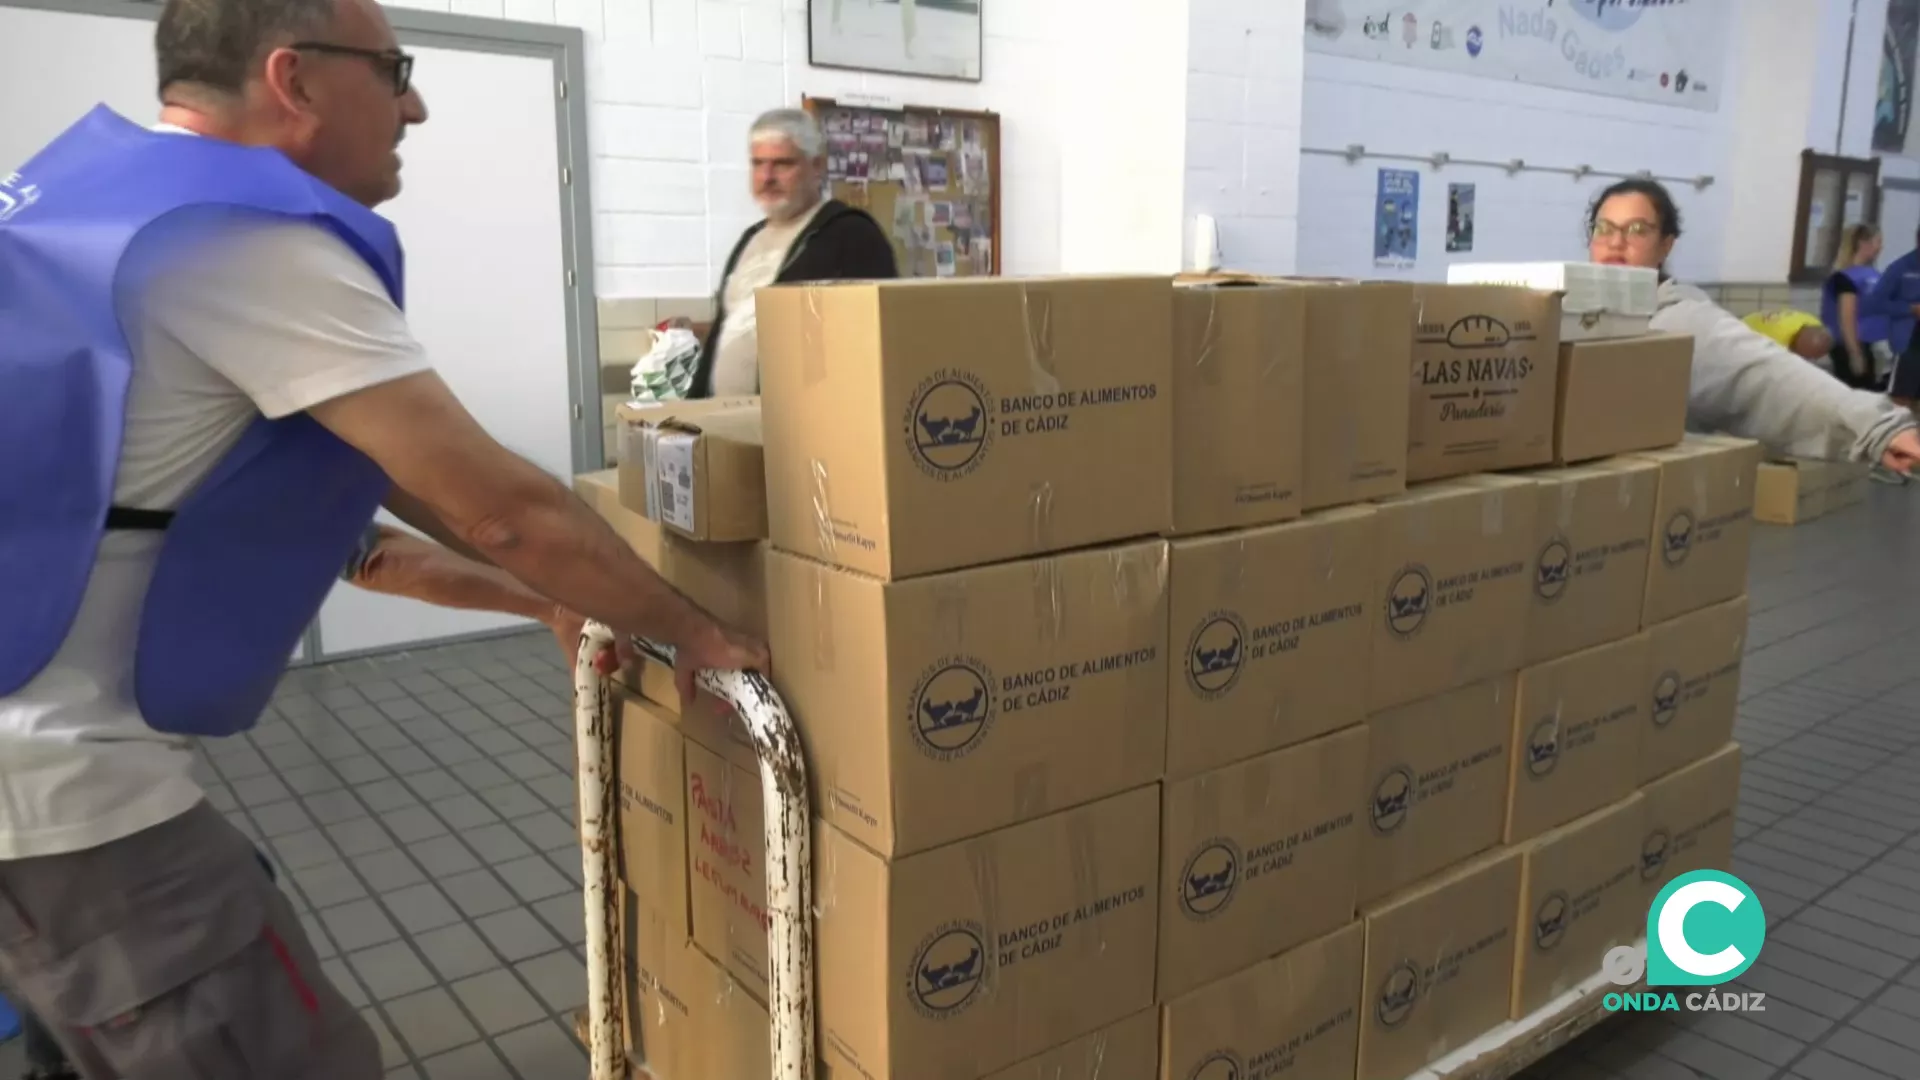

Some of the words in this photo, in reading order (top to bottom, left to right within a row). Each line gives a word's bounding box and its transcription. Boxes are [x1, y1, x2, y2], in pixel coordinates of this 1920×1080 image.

[1422, 360, 1461, 385] LAS
[1467, 356, 1530, 382] NAVAS
[1001, 393, 1053, 414] BANCO
[1058, 391, 1076, 408] DE
[1080, 383, 1157, 406] ALIMENTOS
[1001, 419, 1021, 437] DE
[1253, 620, 1290, 640] BANCO
[1292, 617, 1306, 631] DE
[1308, 602, 1363, 628] ALIMENTOS
[1252, 645, 1265, 659] DE
[1003, 668, 1055, 692] BANCO
[1060, 663, 1079, 681] DE
[1082, 647, 1156, 676] ALIMENTOS
[1003, 694, 1023, 713] DE
[1027, 685, 1071, 708] CÁDIZ
[1247, 840, 1284, 863] BANCO
[1286, 833, 1300, 848] DE
[1302, 812, 1354, 842] ALIMENTOS
[1246, 866, 1259, 880] DE
[999, 921, 1049, 949] BANCO
[1053, 912, 1071, 931] DE
[1073, 886, 1146, 922] ALIMENTOS
[999, 949, 1017, 968] DE
